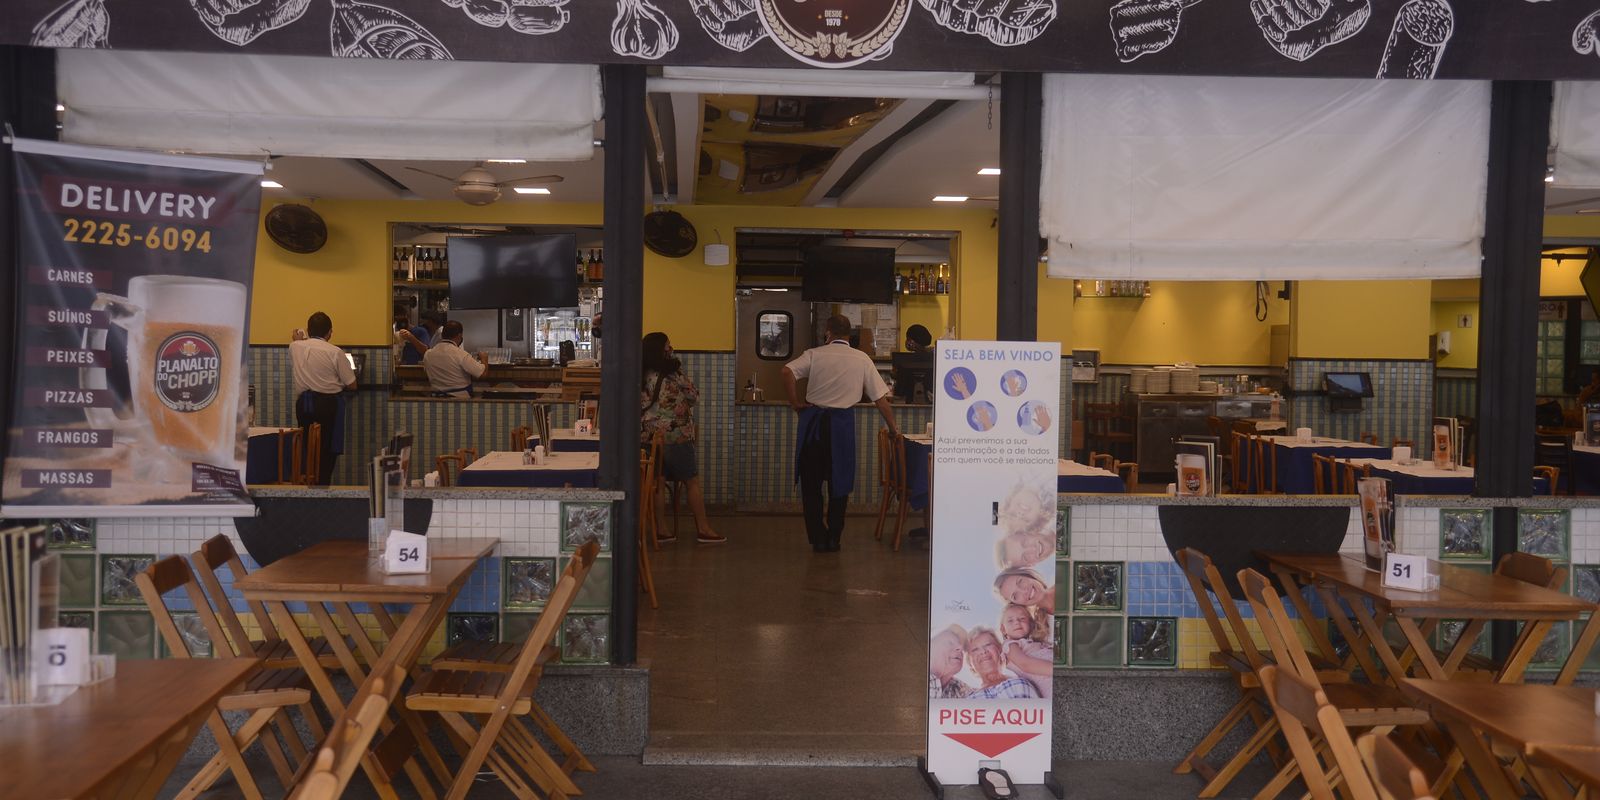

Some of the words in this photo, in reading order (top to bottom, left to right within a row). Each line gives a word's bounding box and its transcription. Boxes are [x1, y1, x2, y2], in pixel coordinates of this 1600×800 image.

[824, 9, 843, 18] DESDE
[60, 183, 217, 220] DELIVERY
[63, 218, 212, 254] 2225-6094
[47, 268, 94, 285] CARNES
[47, 308, 93, 325] SUÍNOS
[47, 351, 95, 365] PEIXES
[944, 349, 975, 361] SEJA
[979, 349, 1006, 361] BEM
[1010, 350, 1054, 362] VINDO
[158, 357, 219, 373] PLANALTO
[157, 372, 168, 381] DO
[167, 370, 218, 390] CHOPP
[45, 390, 94, 404] PIZZAS
[37, 430, 99, 445] FRANGOS
[937, 437, 956, 446] Aqui
[957, 437, 1004, 446] prevenimos
[937, 446, 997, 455] contaminação
[1014, 446, 1027, 455] de
[1027, 447, 1050, 455] todos
[957, 456, 982, 465] quem
[983, 455, 1004, 463] você
[39, 471, 94, 486] MASSAS
[398, 547, 419, 562] 54
[1392, 563, 1411, 578] 51
[939, 708, 987, 726] PISE
[991, 708, 1045, 726] AQUI
